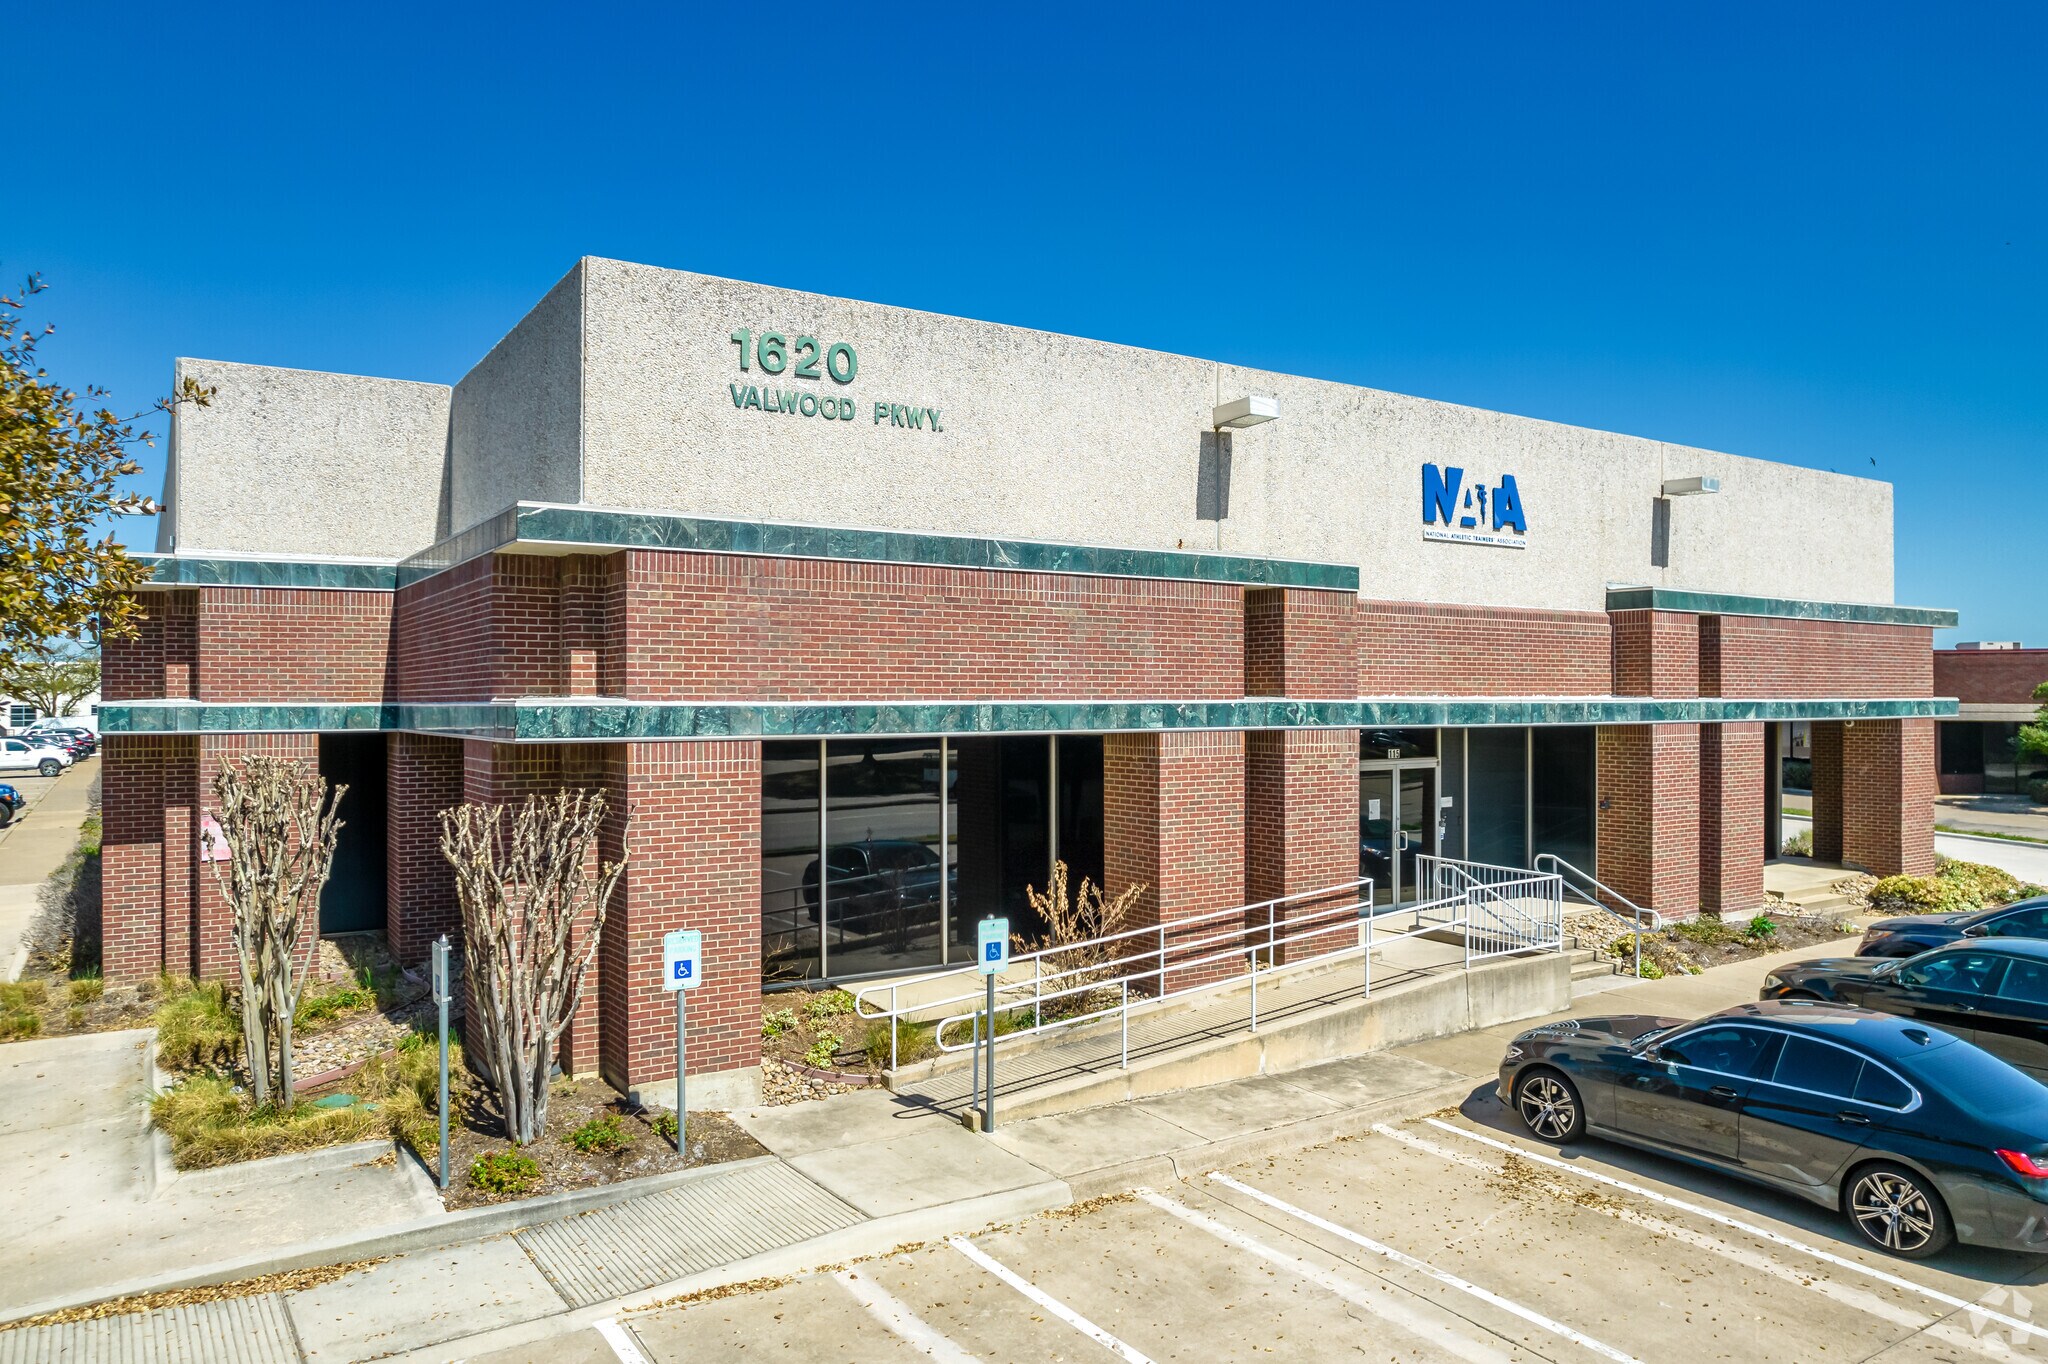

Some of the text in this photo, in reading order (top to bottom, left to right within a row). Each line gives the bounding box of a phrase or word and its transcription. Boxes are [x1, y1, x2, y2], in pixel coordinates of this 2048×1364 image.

[731, 327, 858, 384] 1620
[730, 383, 944, 432] VALWOOD PKWY.
[1425, 531, 1449, 539] NATIONAL
[1451, 533, 1471, 541] ATHLETIC
[1497, 538, 1526, 546] ASSOCIATION
